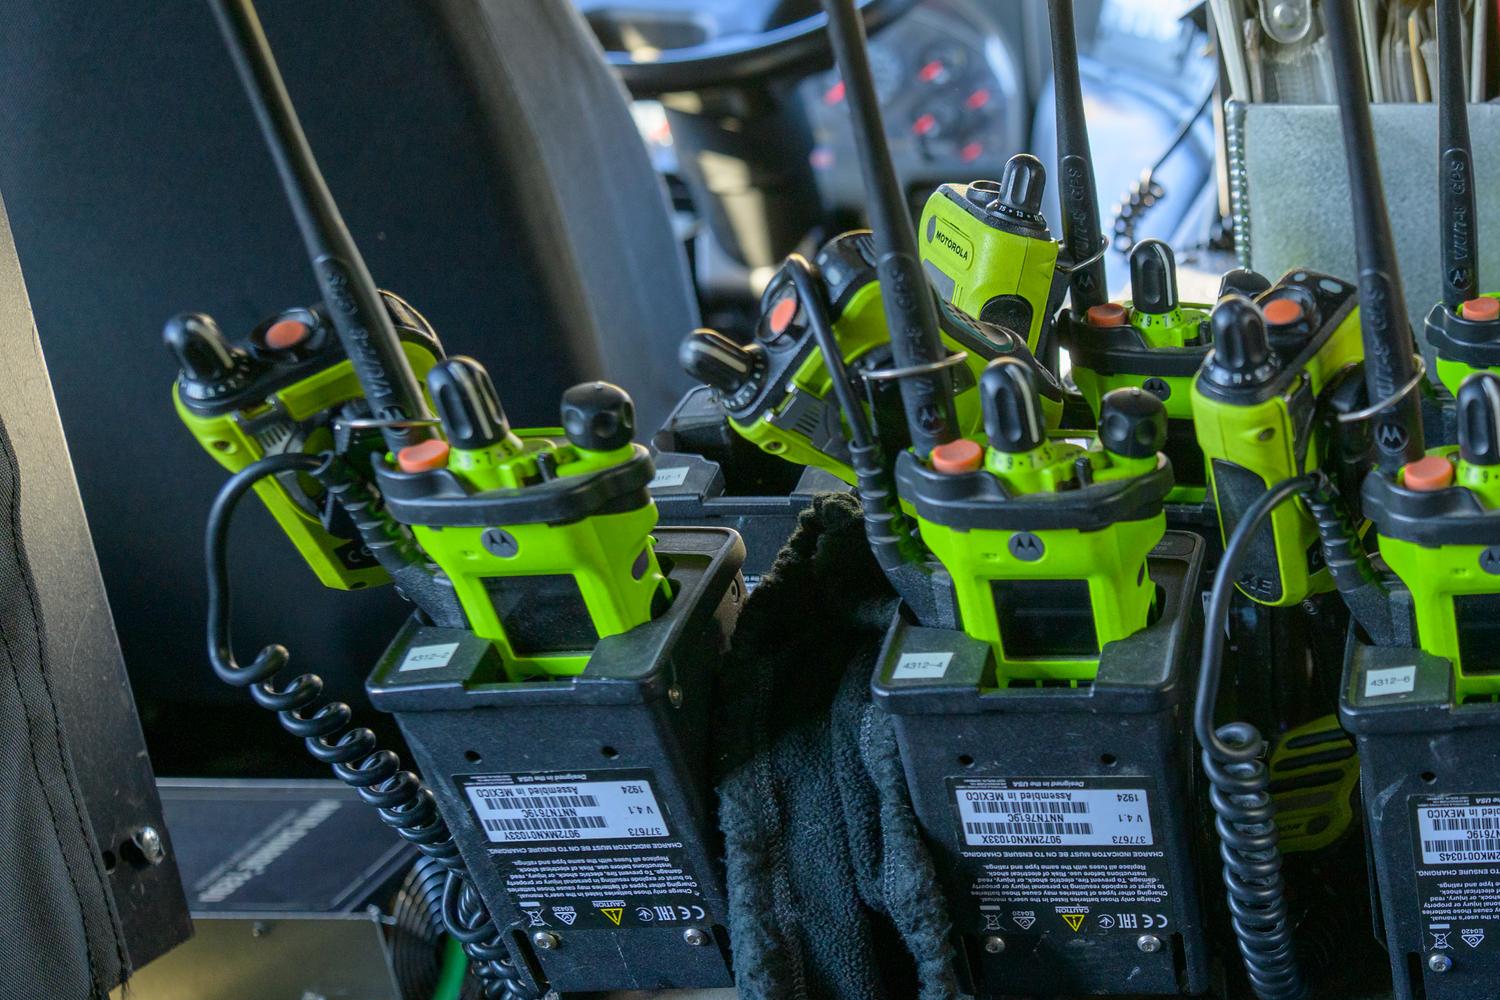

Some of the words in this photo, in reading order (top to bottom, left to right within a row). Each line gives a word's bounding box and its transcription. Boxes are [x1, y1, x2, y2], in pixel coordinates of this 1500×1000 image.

[936, 231, 968, 260] MOTOROLA
[1428, 809, 1465, 818] MEXICO
[628, 827, 662, 836] 377673
[1112, 836, 1146, 844] 377673
